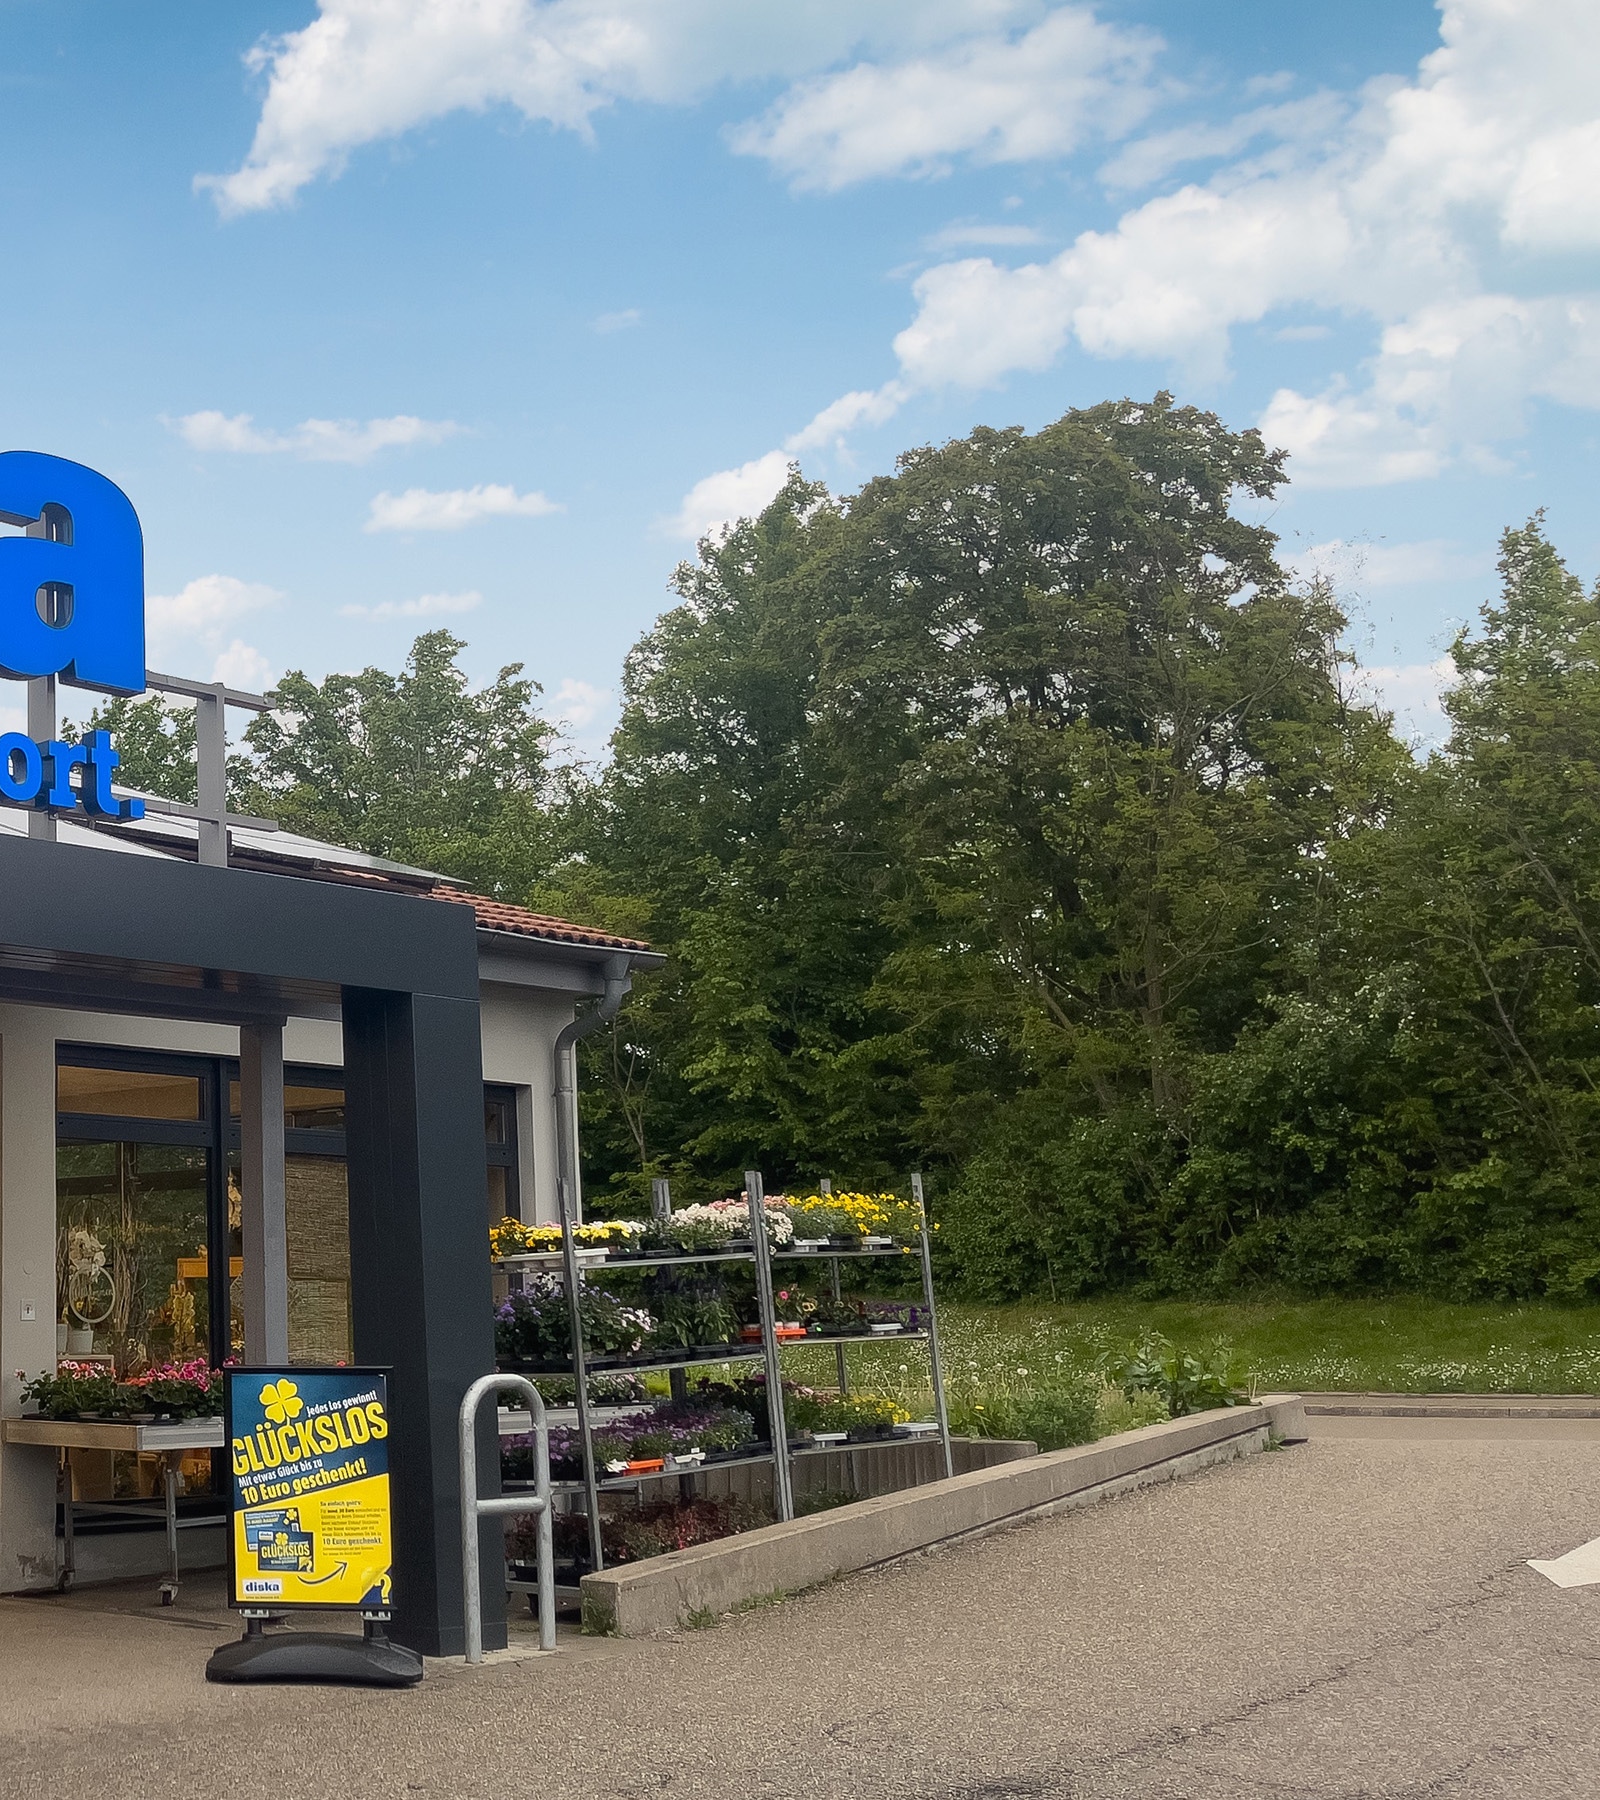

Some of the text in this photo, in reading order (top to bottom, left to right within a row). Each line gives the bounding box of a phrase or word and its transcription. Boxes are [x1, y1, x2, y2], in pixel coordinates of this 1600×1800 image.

[306, 1390, 378, 1417] Jedes Los gewinnt!
[232, 1401, 388, 1476] GLÜCKSLOS
[238, 1458, 323, 1488] Mit etwas Glück bis zu
[241, 1457, 367, 1505] 10 Euro geschenkt!
[245, 1582, 280, 1592] diska
